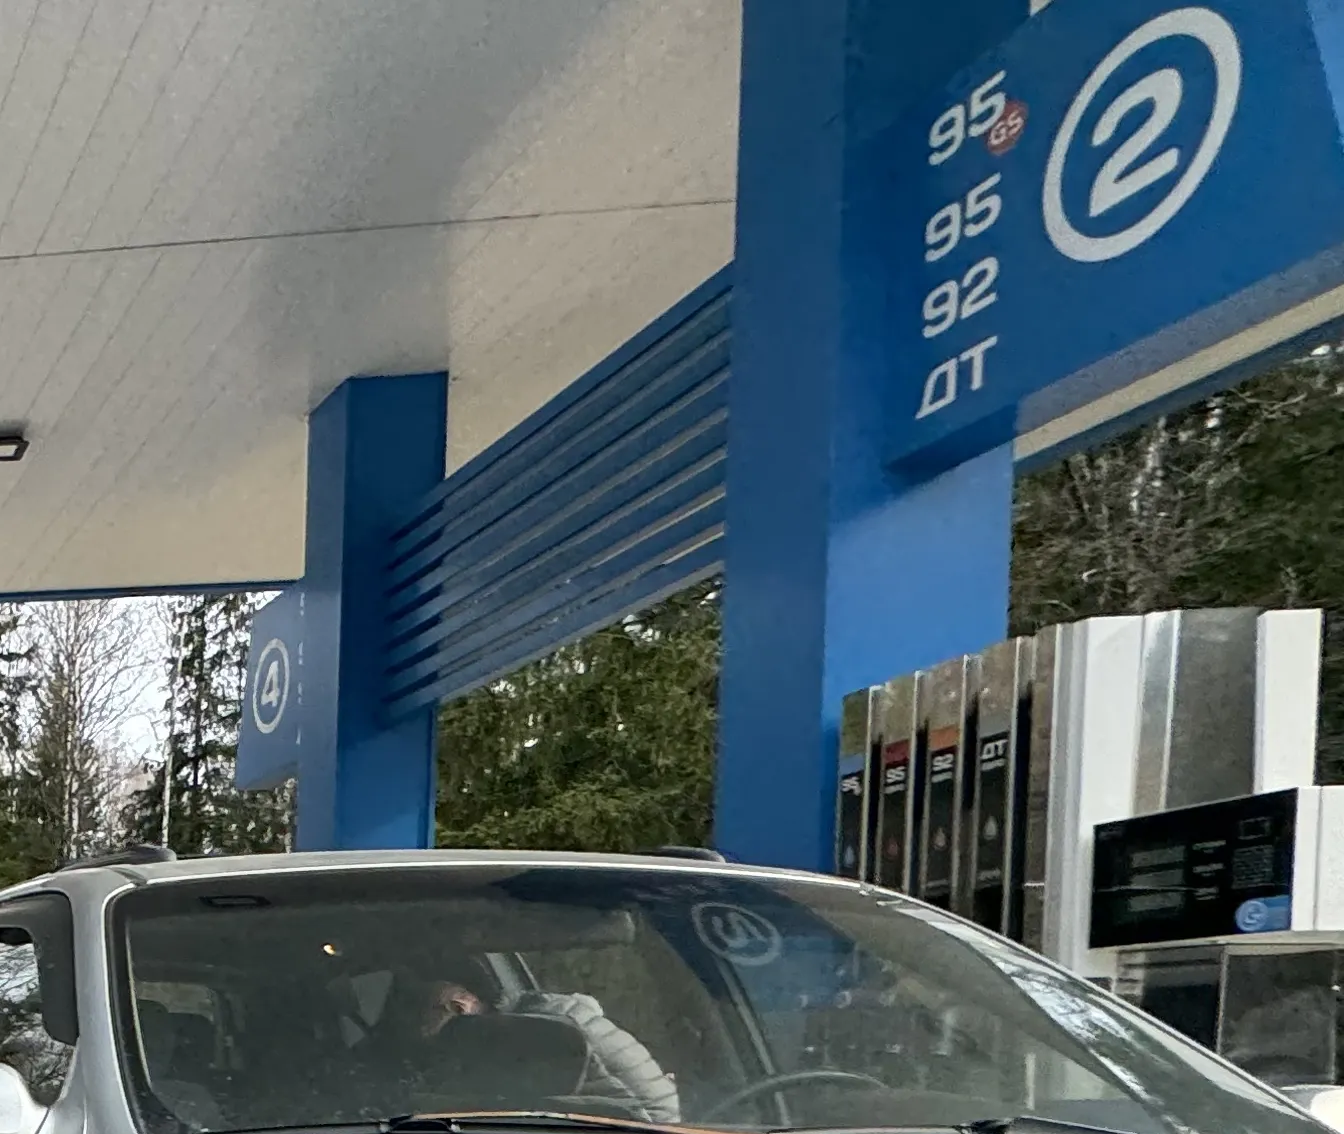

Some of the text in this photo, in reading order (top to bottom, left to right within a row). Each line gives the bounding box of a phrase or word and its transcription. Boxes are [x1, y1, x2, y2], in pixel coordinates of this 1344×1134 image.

[927, 70, 1024, 166] 95 GS
[1090, 67, 1183, 218] 2
[924, 173, 1003, 262] 95
[922, 257, 1000, 339] 92
[915, 336, 999, 420] ДТ
[261, 660, 280, 707] 4
